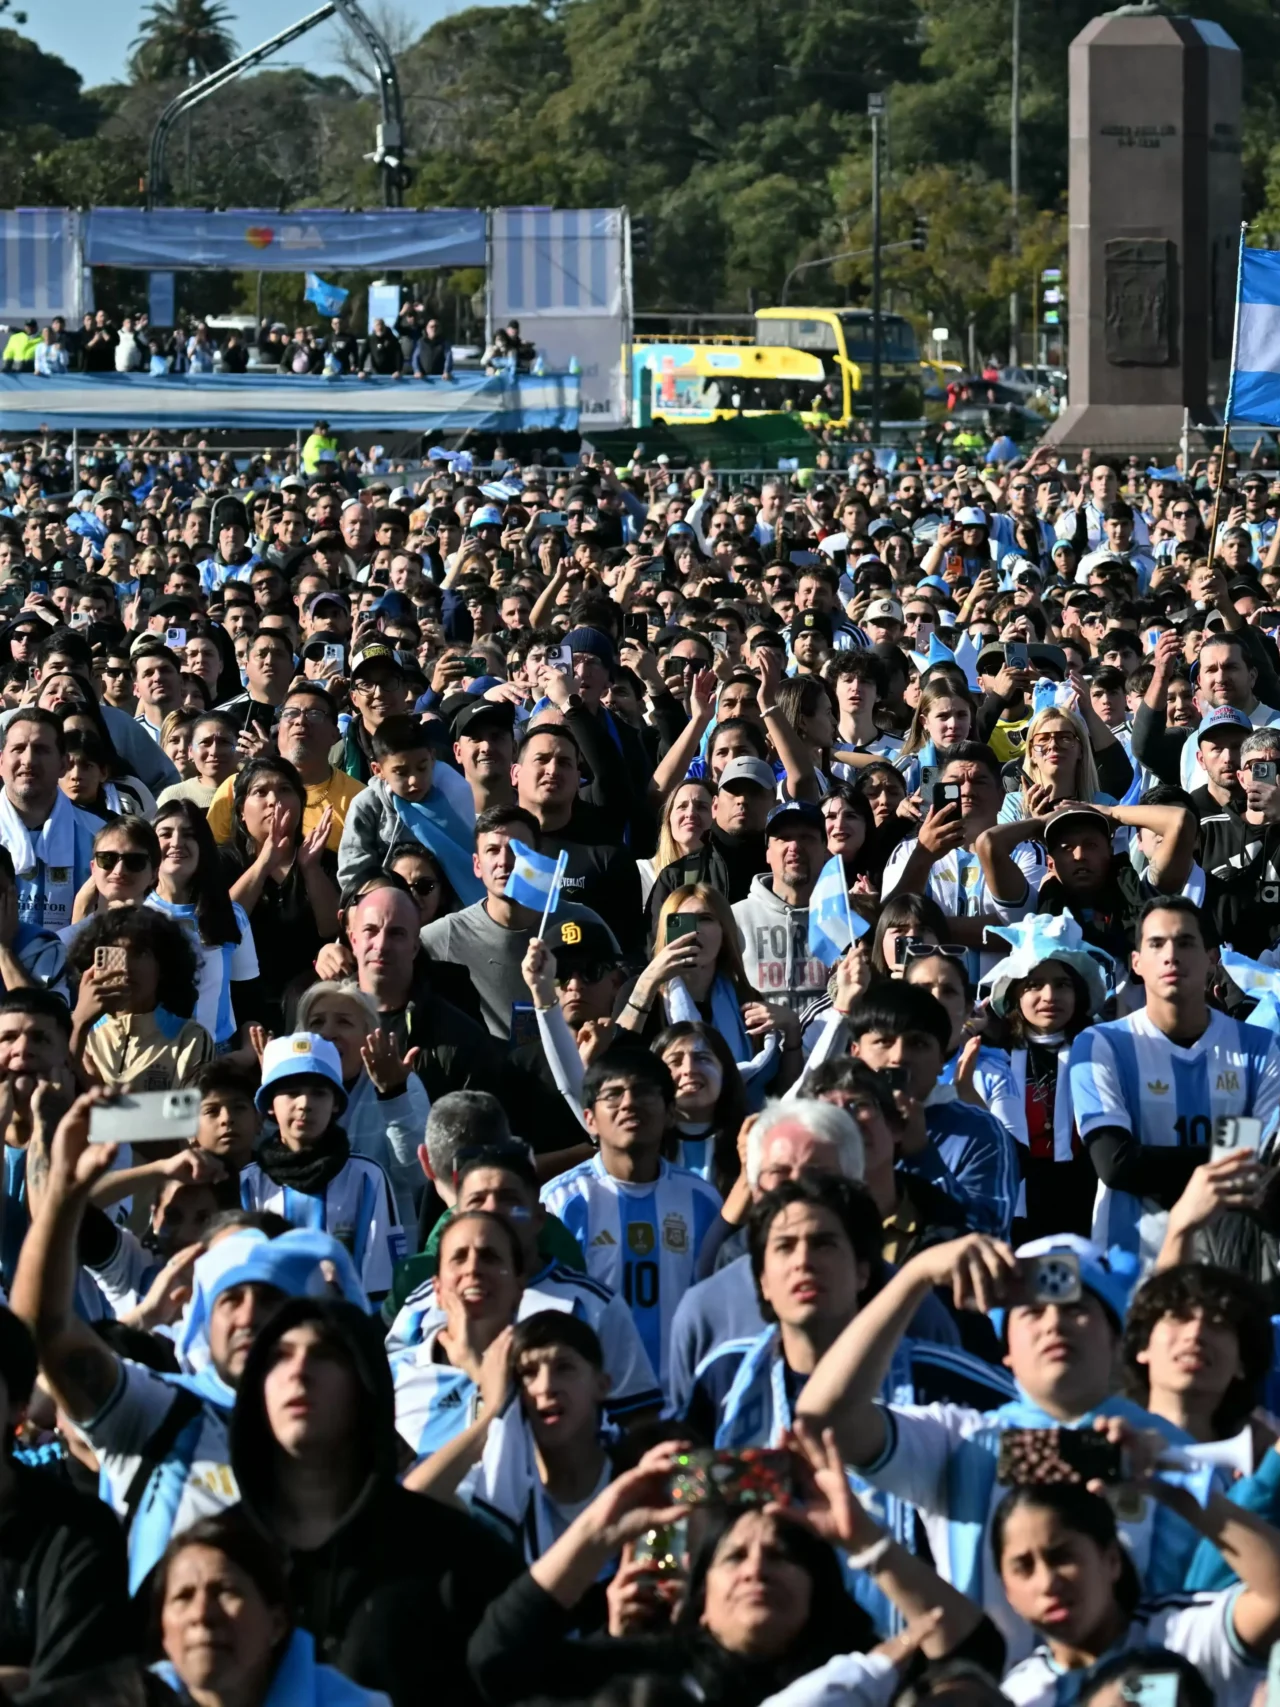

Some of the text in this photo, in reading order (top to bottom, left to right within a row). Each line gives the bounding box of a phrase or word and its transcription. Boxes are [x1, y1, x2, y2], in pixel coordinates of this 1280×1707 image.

[280, 225, 326, 250] BA
[559, 876, 586, 889] EVERLAST
[561, 921, 582, 945] SD
[1216, 1070, 1240, 1097] AFA
[1173, 1114, 1212, 1147] 10
[624, 1260, 659, 1308] 10
